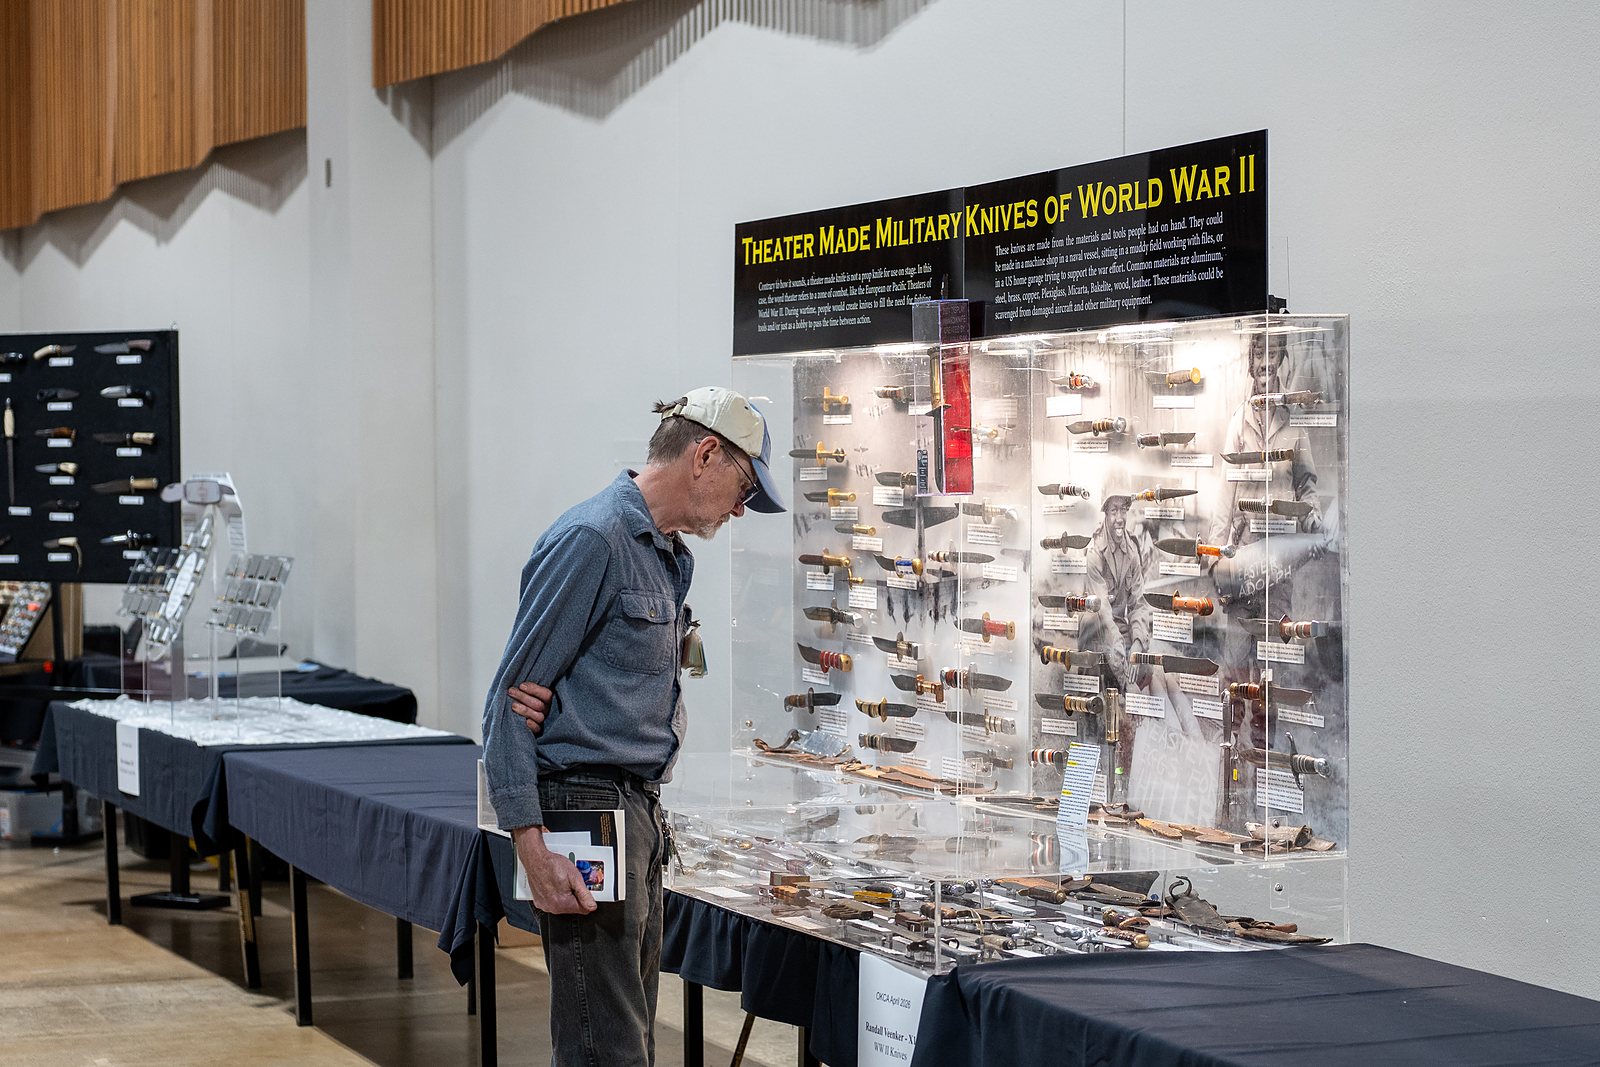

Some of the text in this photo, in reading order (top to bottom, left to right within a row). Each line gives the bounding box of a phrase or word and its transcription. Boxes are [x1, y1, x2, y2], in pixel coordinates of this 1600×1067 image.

[742, 154, 1255, 266] THEATER MADE MILITARY KNIVES OF WORLD WAR II
[995, 212, 1223, 256] These knives are made from the materials and tools people had on hand. They could
[995, 262, 1001, 272] be
[1002, 260, 1014, 270] made
[1015, 260, 1021, 269] in
[1025, 256, 1045, 267] machine
[1046, 254, 1058, 267] shop
[1059, 254, 1065, 264] in
[1070, 250, 1083, 261] naval
[1084, 248, 1100, 260] vessel,
[1102, 246, 1118, 259] sitting
[1118, 245, 1125, 256] in
[1130, 241, 1149, 255] muddy
[1150, 239, 1161, 251] field
[1163, 236, 1186, 250] working
[1187, 233, 1200, 246] with
[1202, 232, 1215, 244] files,
[1216, 233, 1223, 242] or
[995, 278, 1000, 288] in
[1005, 276, 1012, 286] US
[1013, 275, 1027, 286] home
[1028, 276, 1043, 287] garage
[1044, 271, 1060, 284] trying
[1060, 271, 1067, 279] to
[1067, 268, 1087, 281] support
[1089, 265, 1097, 276] the
[1098, 266, 1108, 274] war
[1109, 261, 1126, 274] effort.
[1126, 261, 1152, 271] Common
[1154, 254, 1179, 268] materials
[1181, 256, 1189, 264] are
[1191, 251, 1223, 263] aluminum,
[995, 266, 1223, 304] steel, brass, copper, Plexiglass, Micarta, Bakelite, wood, leather. These materials could be
[758, 308, 769, 318] World
[785, 306, 799, 318] During
[800, 305, 817, 314] wartime,
[818, 303, 831, 316] people
[832, 302, 845, 311] would
[859, 300, 872, 310] knives
[873, 300, 879, 308] to
[895, 296, 905, 306] need
[995, 294, 1152, 321] scavenged from damaged aircraft and other military equipment.
[758, 322, 767, 332] tools
[768, 321, 780, 331] and/or
[796, 320, 808, 331] hobby
[813, 320, 822, 330] pass
[830, 318, 838, 326] time
[839, 316, 856, 325] between
[857, 315, 871, 324] action.
[876, 992, 889, 1002] OKCA
[889, 996, 899, 1006] April
[866, 1021, 883, 1035] Randall
[884, 1027, 904, 1041] Veenker
[890, 1047, 907, 1060] Knives
